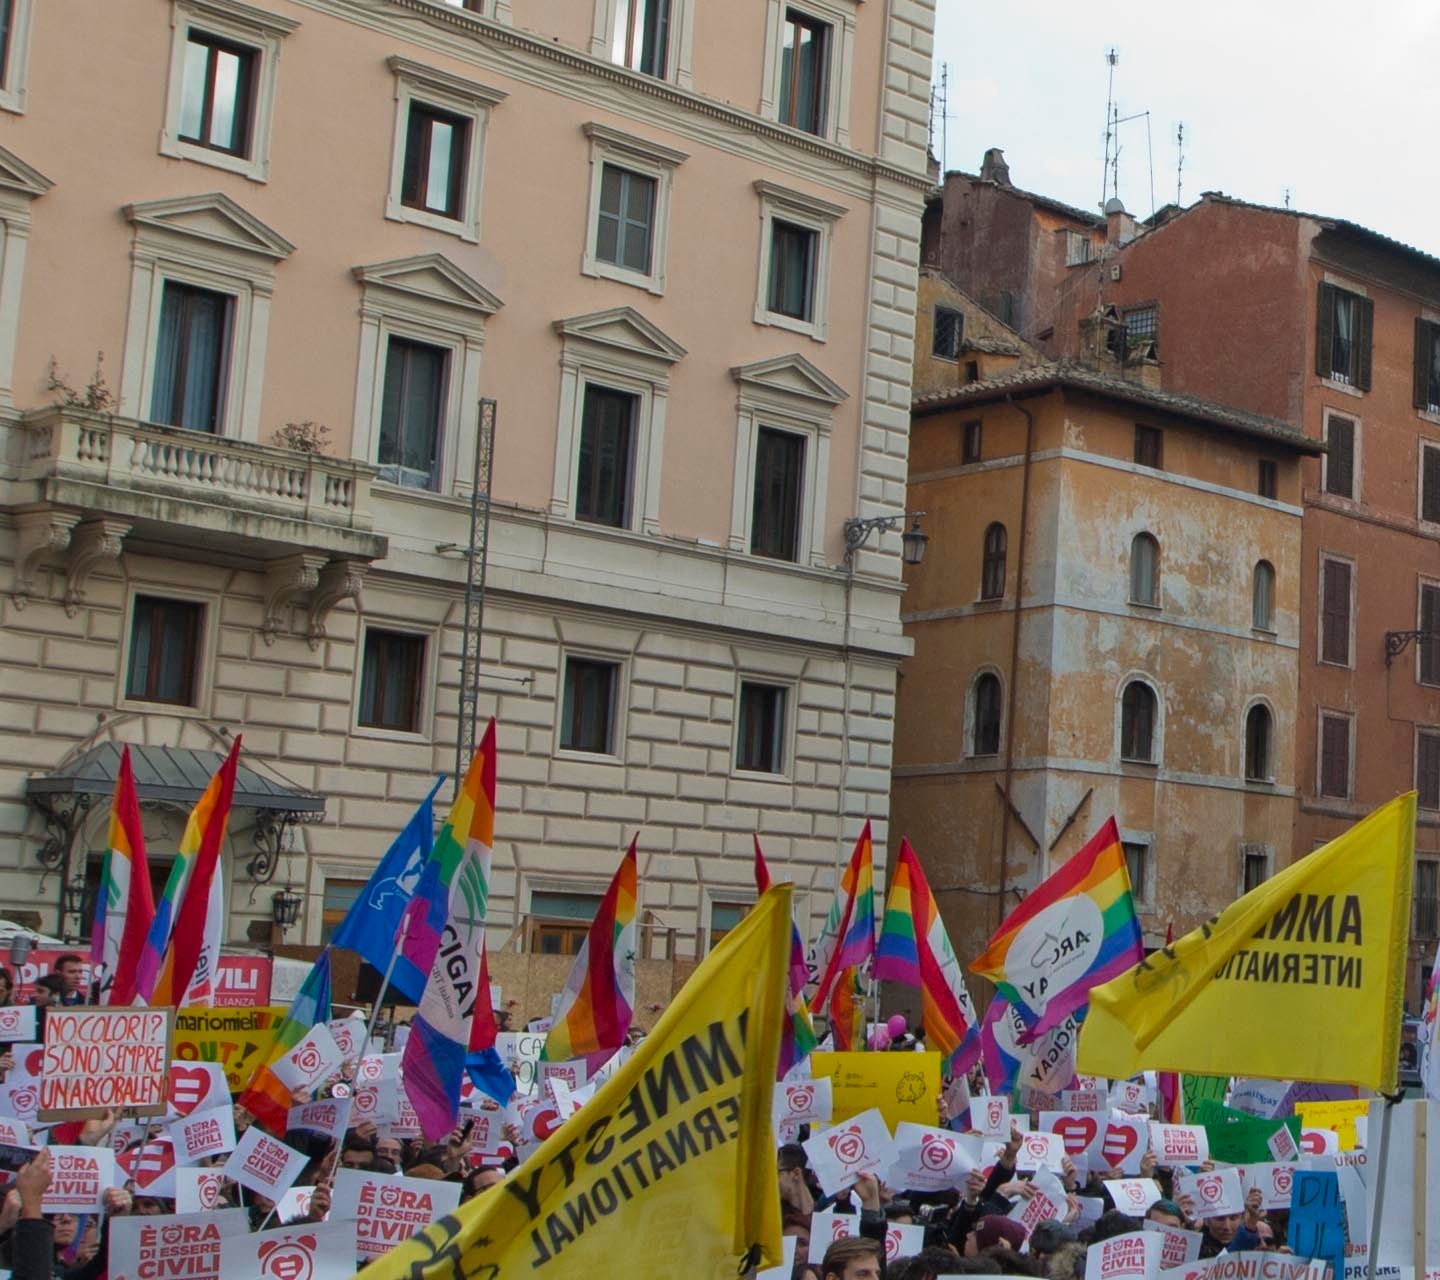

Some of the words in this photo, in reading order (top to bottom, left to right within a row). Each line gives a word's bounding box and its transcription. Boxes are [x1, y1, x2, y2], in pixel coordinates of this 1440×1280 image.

[48, 1016, 76, 1044] NO
[45, 1045, 100, 1075] SONO
[105, 1045, 164, 1074] SEMPRE
[44, 1181, 99, 1195] CIVILI
[359, 1181, 377, 1204] È
[380, 1185, 433, 1211] ORA
[357, 1206, 372, 1216] DI
[375, 1208, 432, 1224] ESSERE
[140, 1224, 156, 1247] È
[162, 1224, 221, 1245] ORA
[356, 1217, 416, 1241] CIVIL
[139, 1247, 157, 1261] DI
[159, 1242, 221, 1258] ESSERE
[137, 1253, 221, 1280] CIVILI
[1101, 1258, 1145, 1272] CIVILI
